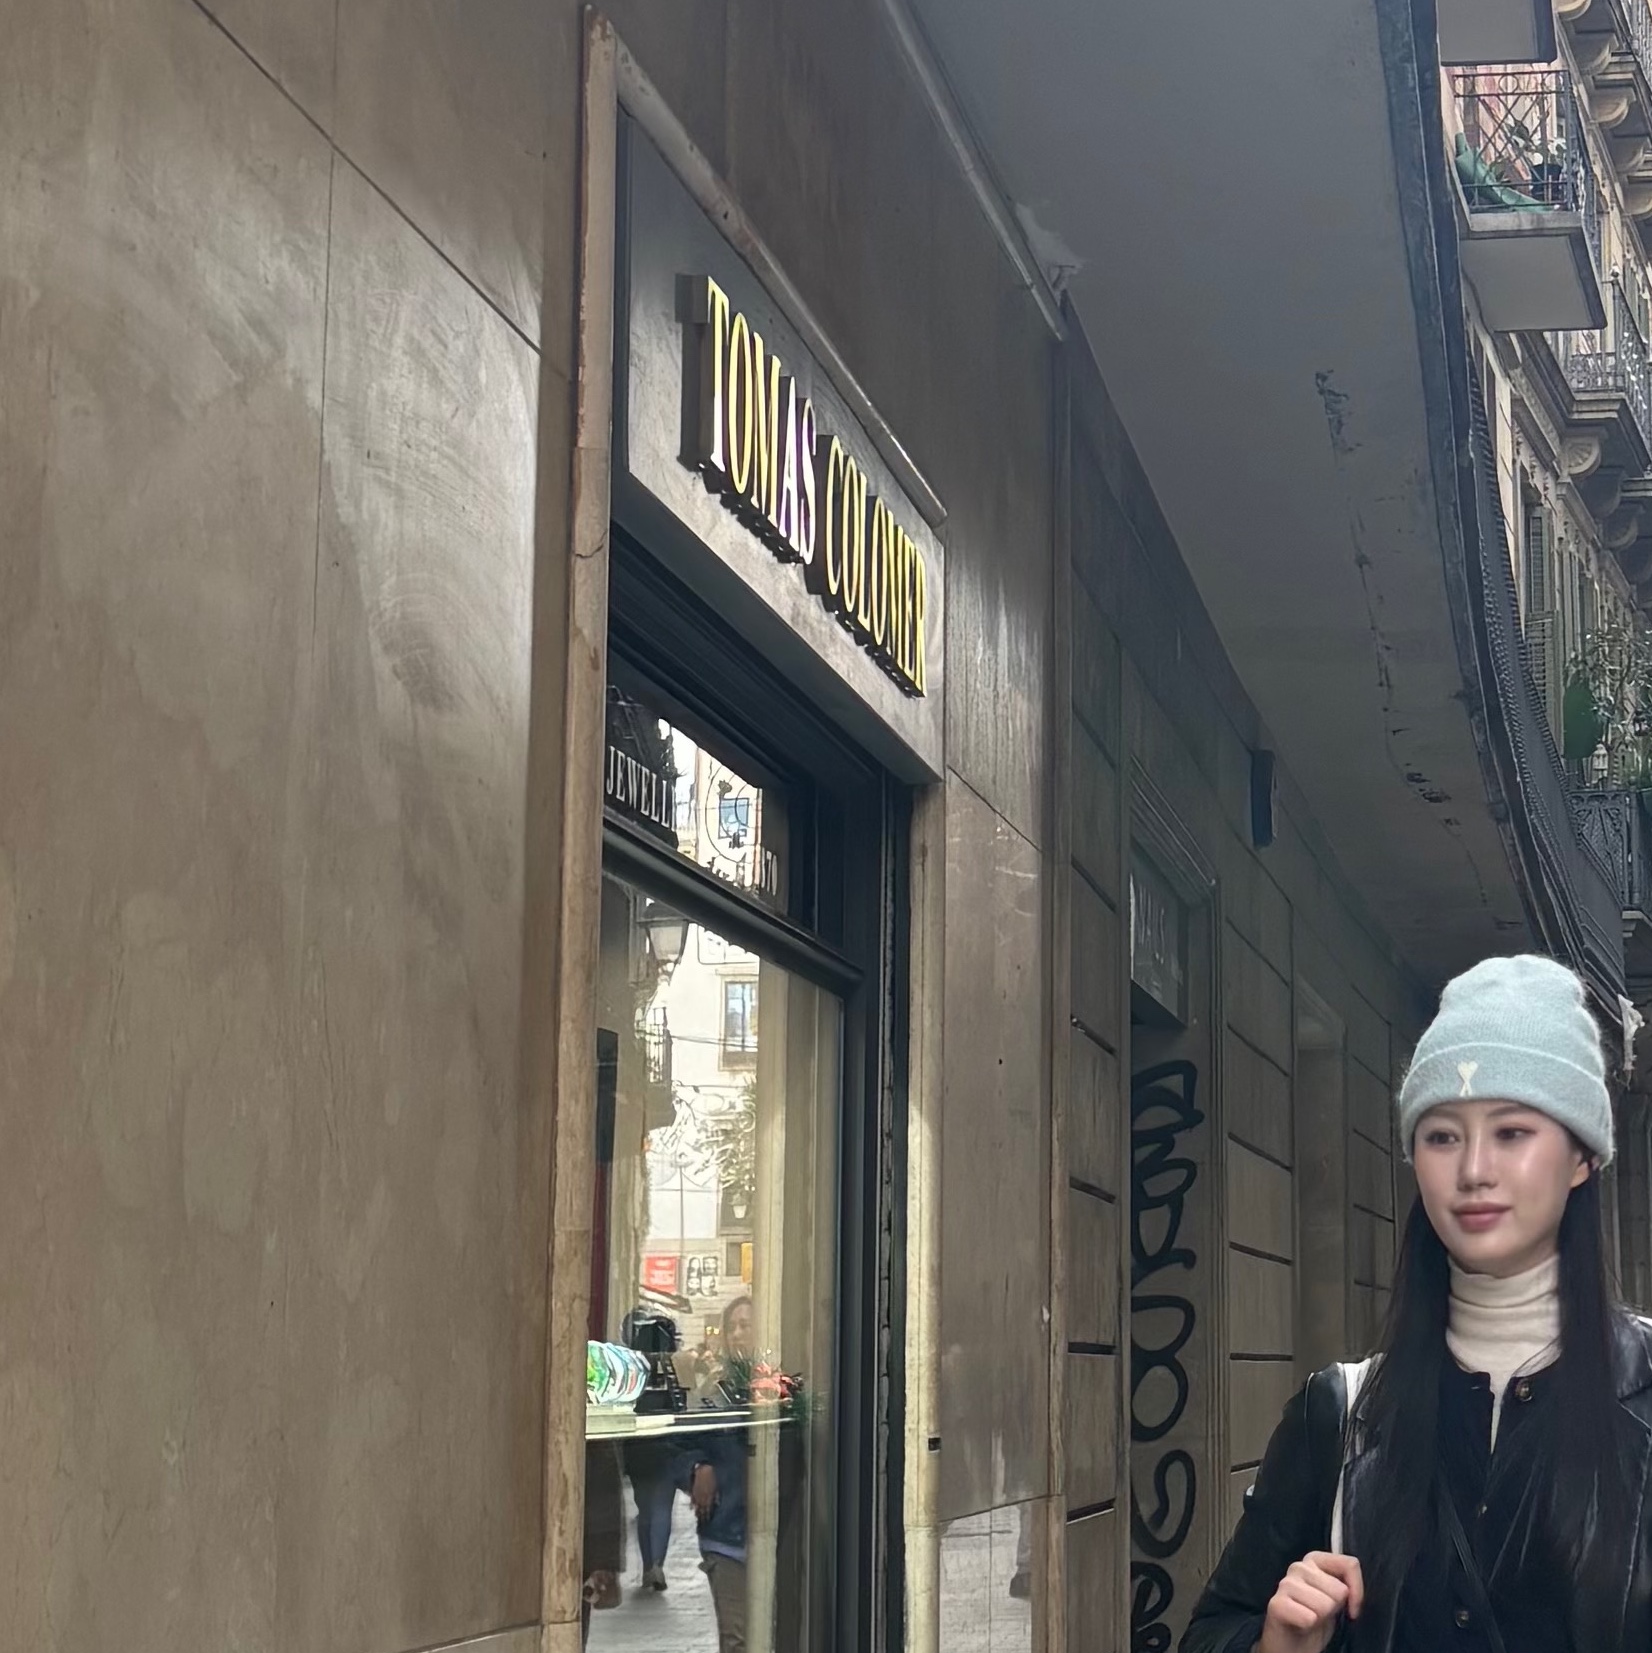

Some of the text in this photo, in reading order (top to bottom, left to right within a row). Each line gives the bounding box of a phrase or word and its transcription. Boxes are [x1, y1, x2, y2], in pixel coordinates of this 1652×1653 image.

[707, 275, 928, 698] TOMAS COLOMER
[606, 745, 677, 833] JEWELL
